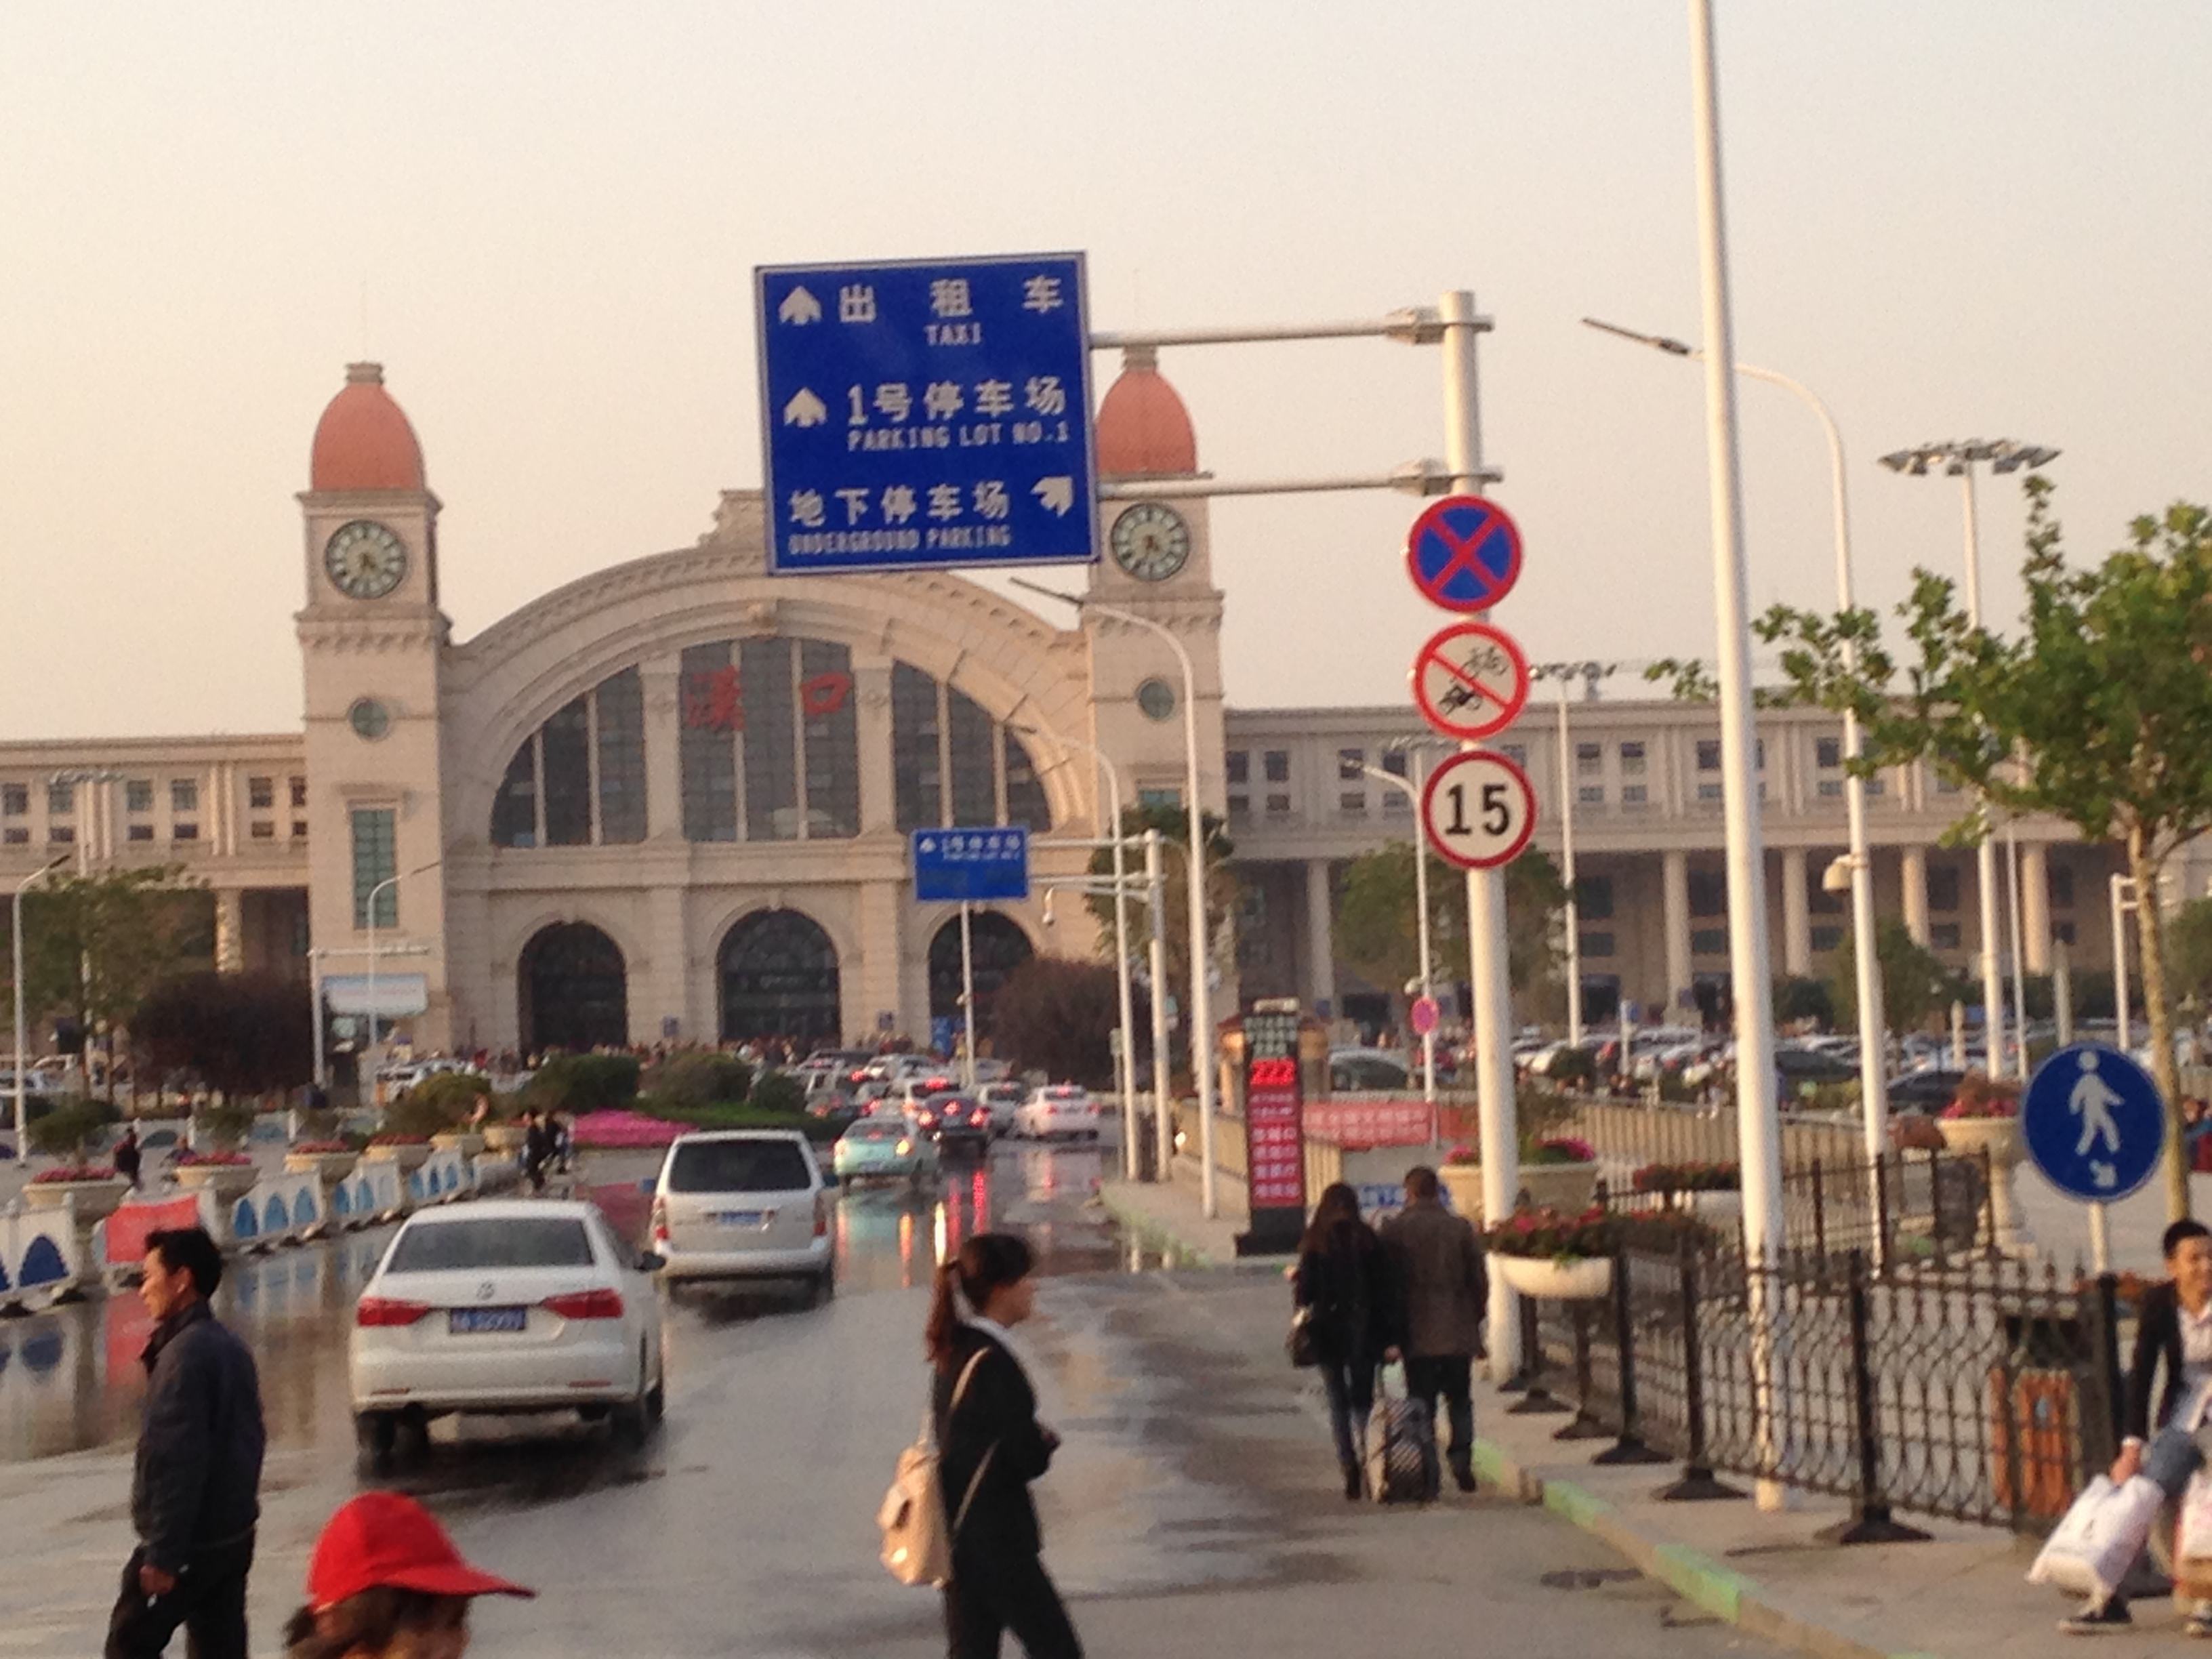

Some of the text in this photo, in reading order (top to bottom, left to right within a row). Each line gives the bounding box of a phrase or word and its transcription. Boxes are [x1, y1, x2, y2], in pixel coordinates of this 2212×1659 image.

[838, 274, 1064, 324] 出租车
[924, 322, 981, 346] TAXI
[847, 376, 1067, 426] 1号停车场
[847, 421, 1069, 452] PARKING LOT NO.1
[788, 480, 1010, 528] 地下停车场
[925, 525, 1012, 550] PARKING
[1445, 784, 1509, 836] 15
